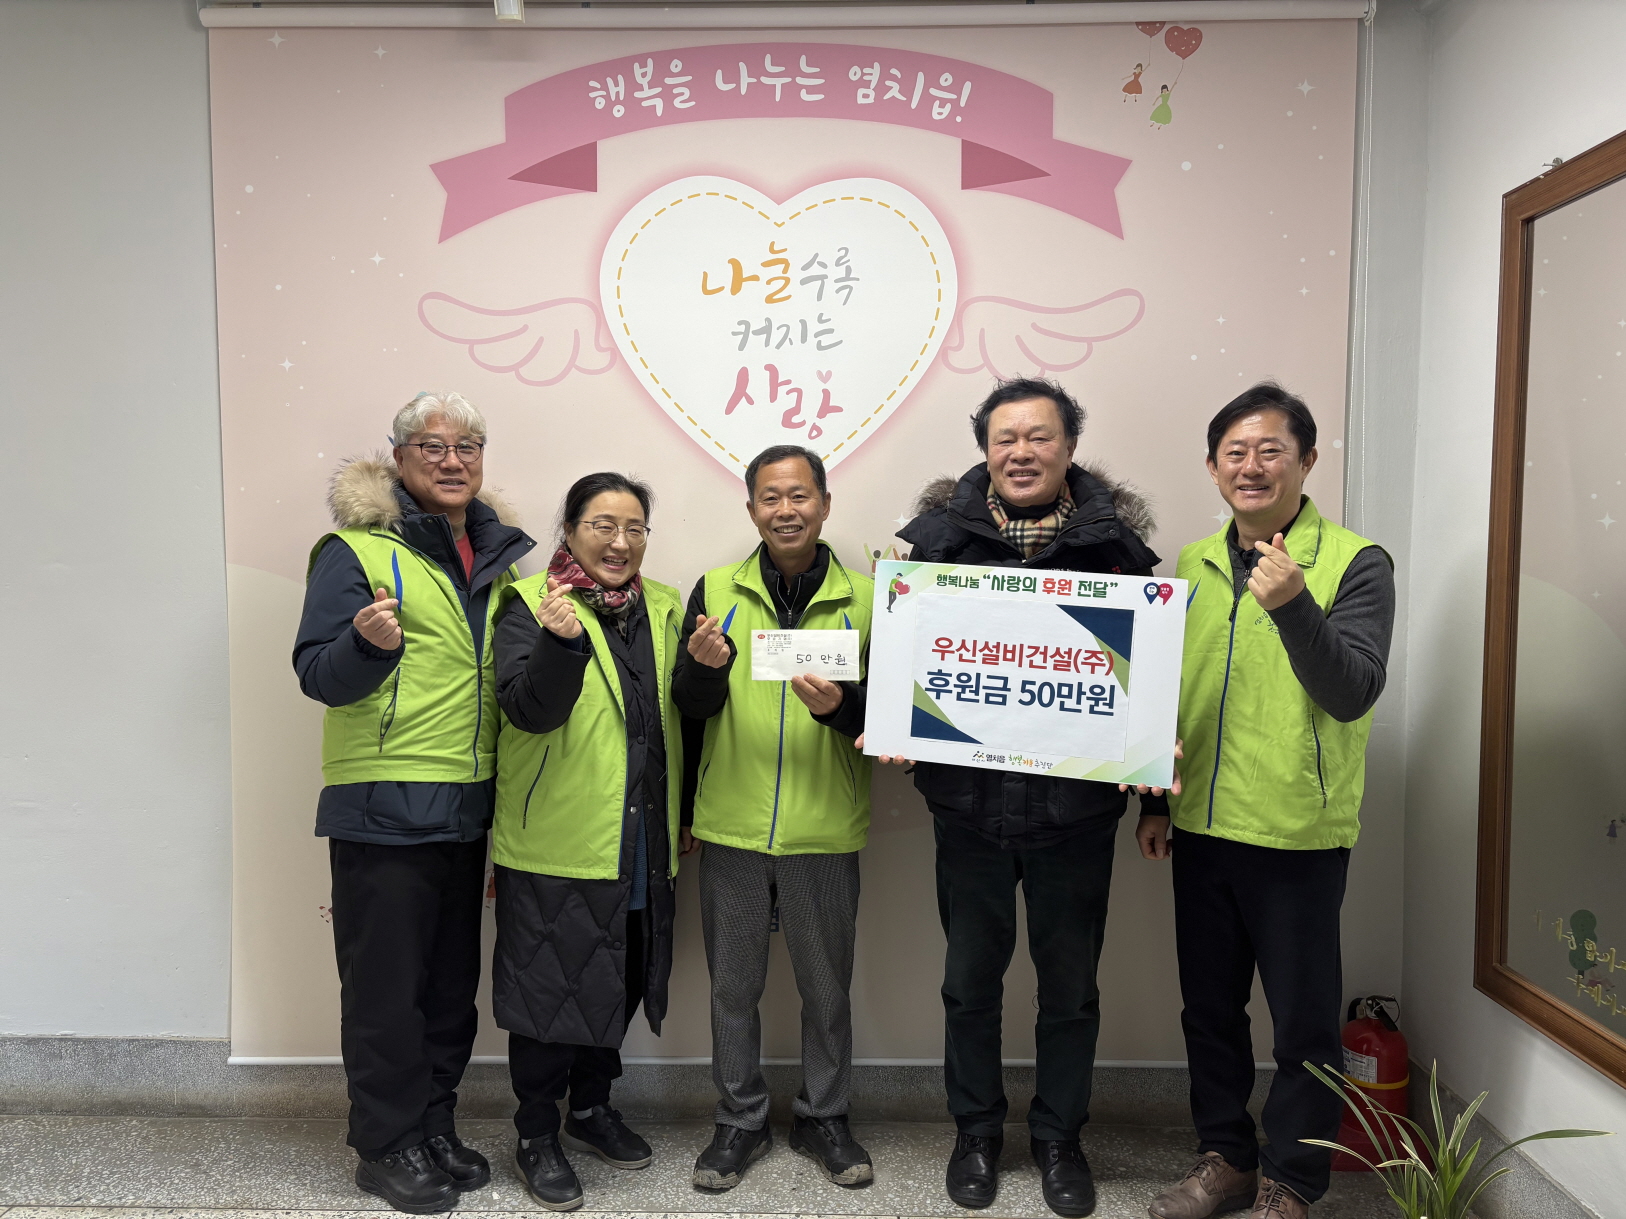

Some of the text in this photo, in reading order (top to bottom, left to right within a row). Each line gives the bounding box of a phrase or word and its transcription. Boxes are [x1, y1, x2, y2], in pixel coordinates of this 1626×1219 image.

[588, 53, 973, 124] 행복을 나누는 염치읍!
[700, 241, 861, 307] 나눌수록
[731, 313, 845, 353] 커지는
[724, 363, 844, 441] 사랑
[936, 573, 980, 590] 행복나눔
[1042, 578, 1073, 597] 후원
[796, 653, 848, 666] 50 만원
[932, 636, 1114, 676] 우신설비건설(주)
[924, 668, 1116, 717] 후원금 50만원
